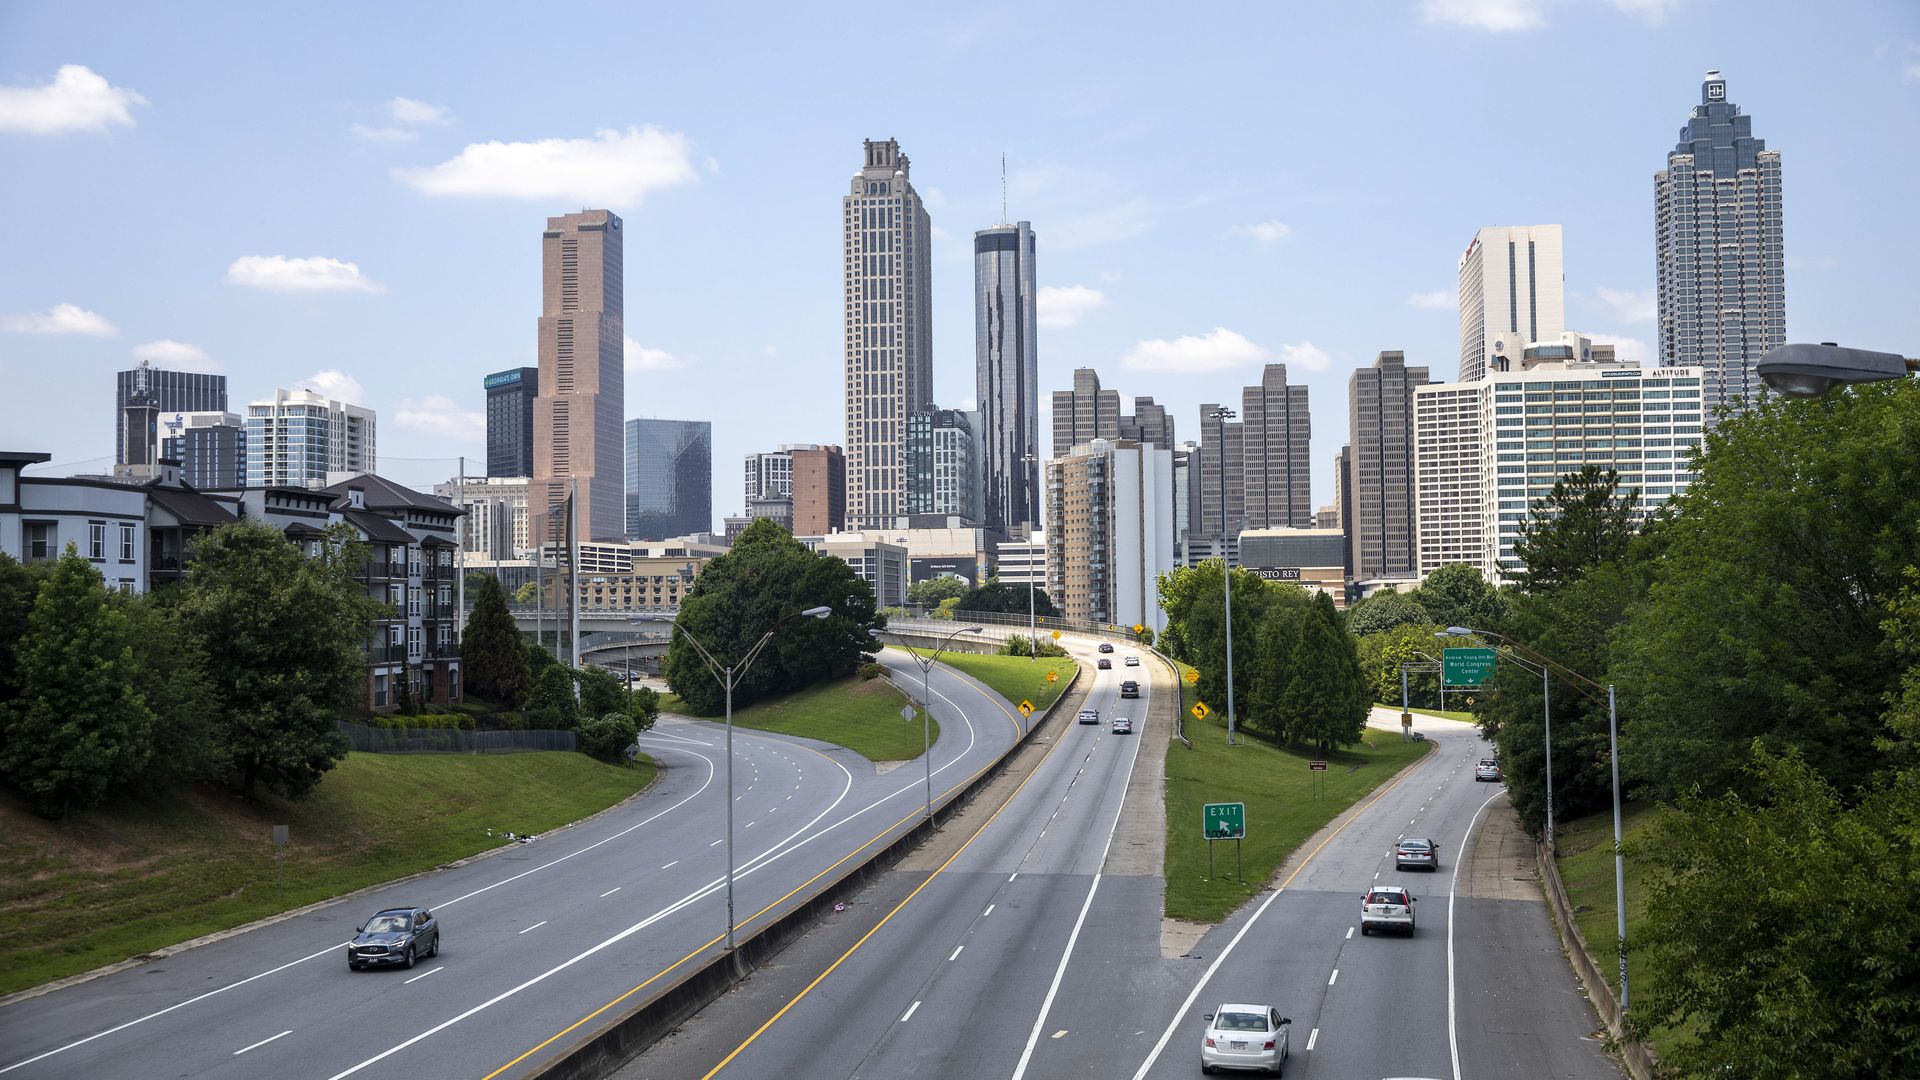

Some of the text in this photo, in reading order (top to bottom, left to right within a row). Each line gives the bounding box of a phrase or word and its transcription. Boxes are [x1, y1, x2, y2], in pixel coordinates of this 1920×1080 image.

[1652, 369, 1689, 377] ALTITUDE
[489, 372, 520, 385] GEORGIA'S OWN
[1282, 570, 1299, 578] REY
[1210, 806, 1237, 816] EXIT
